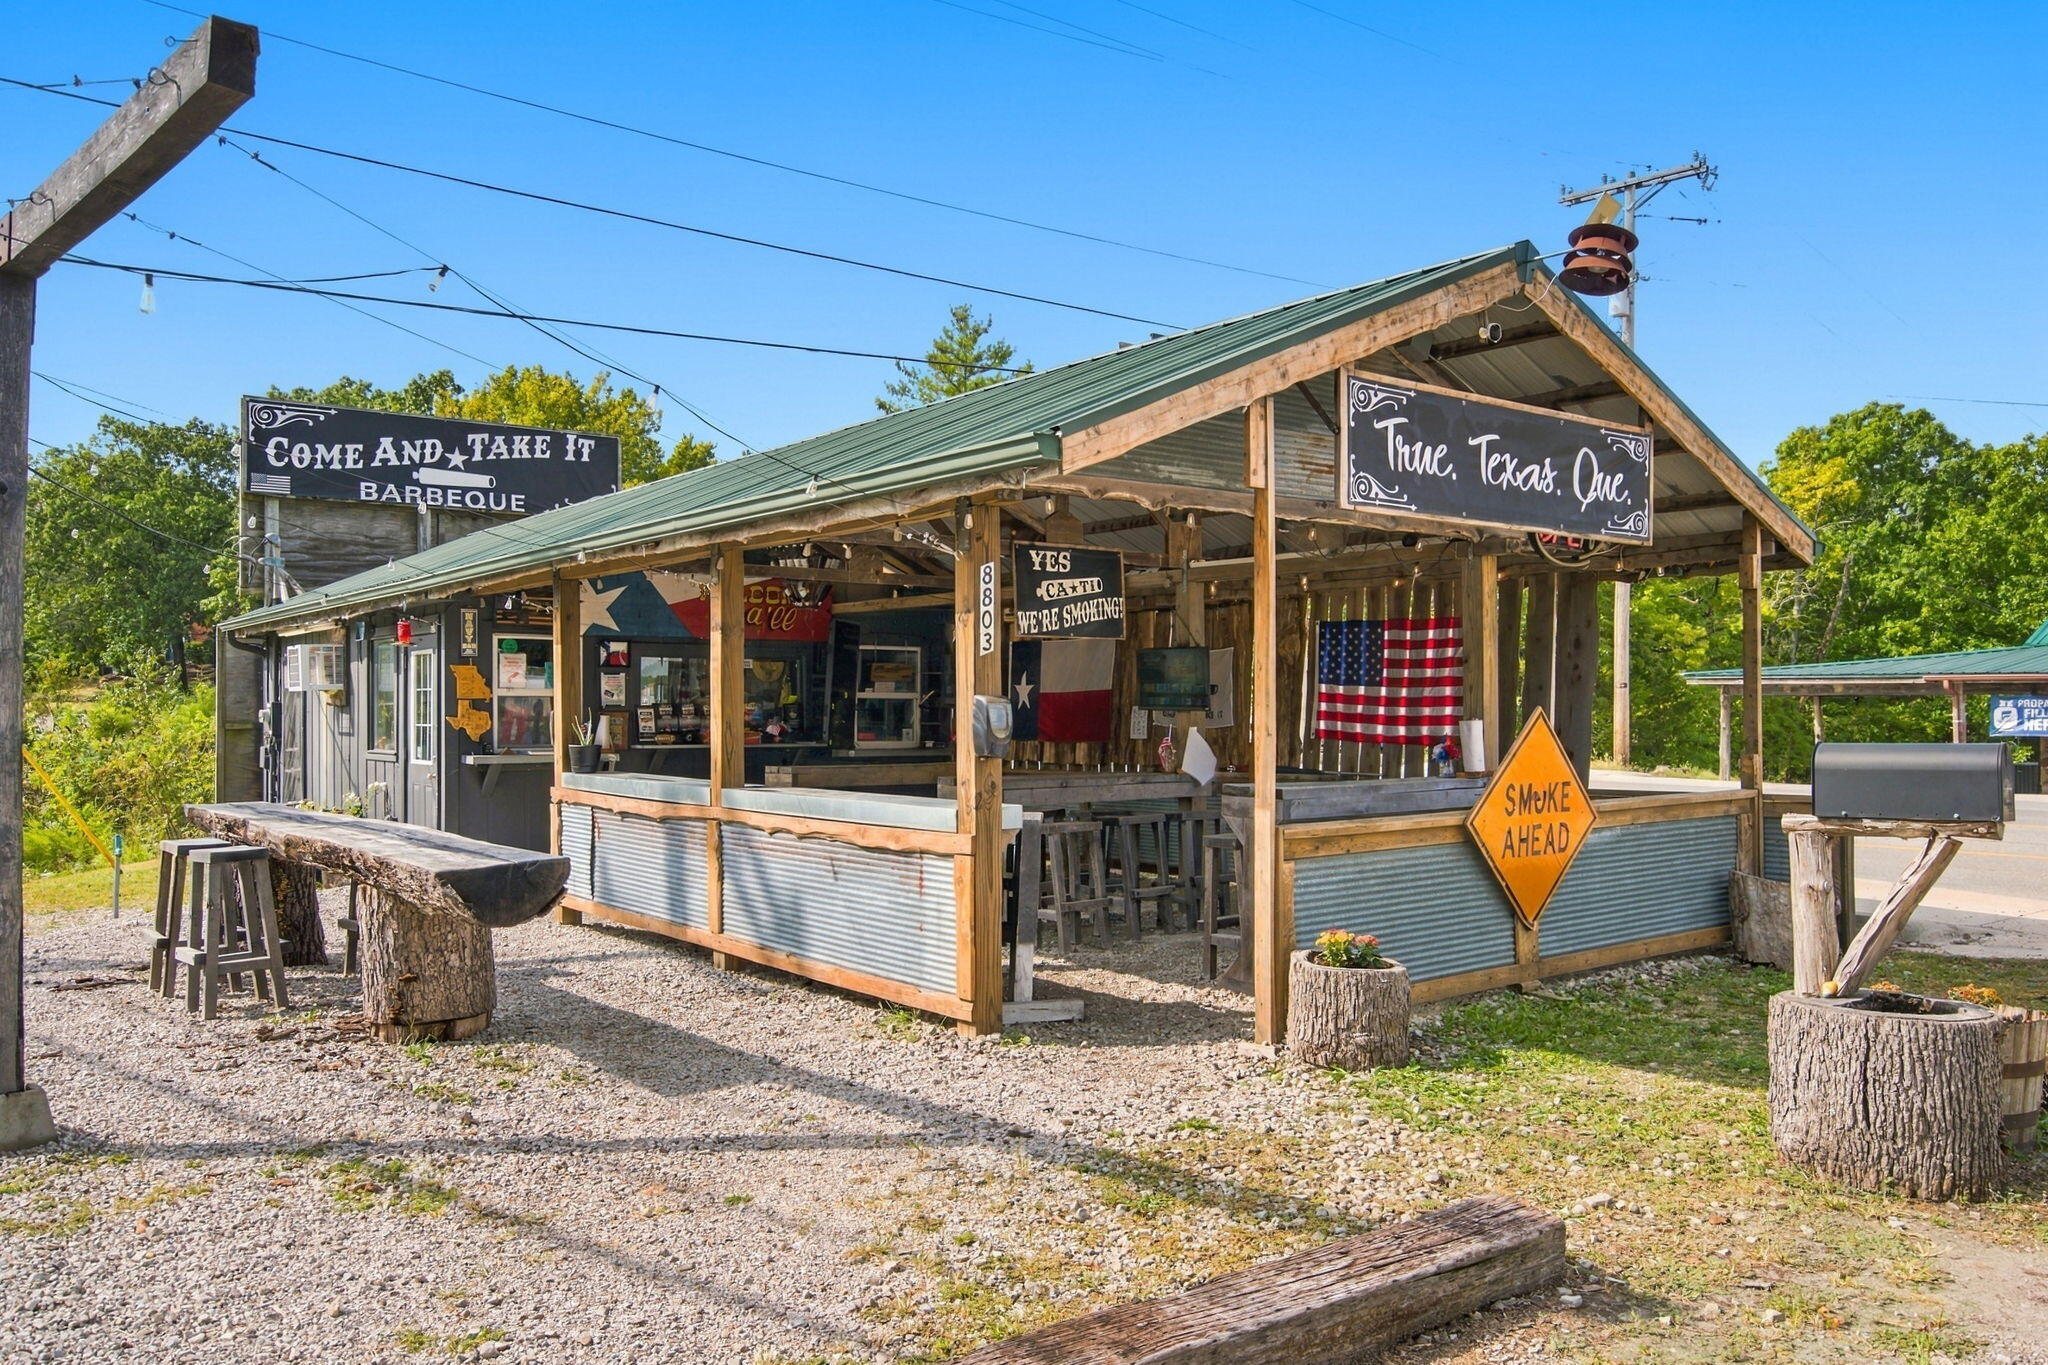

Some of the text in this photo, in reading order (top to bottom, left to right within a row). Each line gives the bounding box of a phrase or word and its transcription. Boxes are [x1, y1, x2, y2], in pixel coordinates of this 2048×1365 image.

[265, 433, 595, 469] COME AND TAKE IT
[1373, 417, 1632, 513] True. Texas. Que.
[360, 481, 526, 512] BARBEQUE
[1029, 550, 1071, 573] YES
[746, 606, 798, 631] a'll
[982, 565, 993, 651] 8803
[1018, 597, 1123, 634] WE'RE SMOKING!
[1501, 822, 1570, 859] AHEAD
